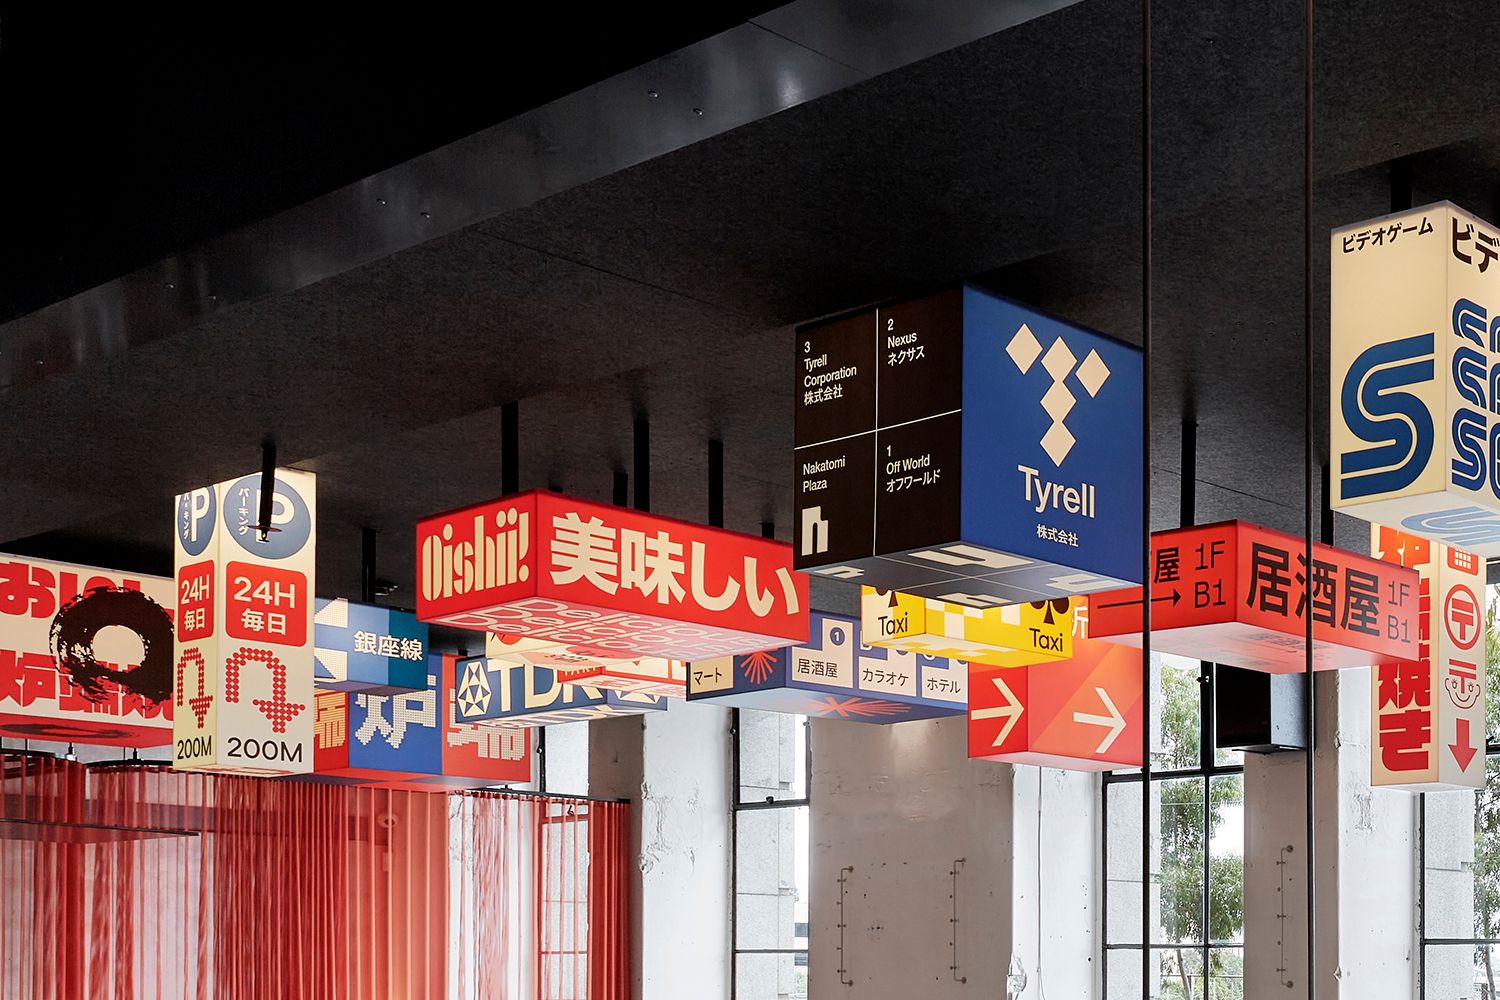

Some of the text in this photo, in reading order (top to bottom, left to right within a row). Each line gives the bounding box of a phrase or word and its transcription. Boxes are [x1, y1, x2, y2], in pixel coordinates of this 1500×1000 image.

[1342, 216, 1435, 255] ビデオゲーム
[887, 318, 894, 331] 2
[804, 341, 811, 353] 3
[887, 332, 918, 349] Nexus
[804, 354, 828, 372] Tyrell
[887, 345, 925, 367] ネクサス
[803, 366, 857, 388] Corporation
[803, 384, 843, 406] 株式会社
[886, 445, 892, 457] 1
[886, 453, 931, 475] Off World
[802, 455, 846, 476] Nakatomi
[802, 478, 828, 493] Plaza
[886, 469, 942, 493] オフワールド
[1017, 464, 1096, 519] Tyrell
[190, 485, 210, 543] P
[237, 487, 250, 537] パーキング
[1036, 523, 1080, 548] 株式会社
[421, 507, 531, 602] Oishii!
[549, 512, 801, 618] 美味しい
[1195, 539, 1227, 572] 1F
[181, 573, 211, 605] 24H
[233, 575, 297, 610] 24H
[1194, 578, 1228, 609] B1
[1246, 541, 1382, 638] 居酒屋
[1388, 579, 1412, 609] 1F
[183, 607, 206, 632] 毎日
[241, 608, 287, 635] 毎日
[878, 611, 909, 637] Taxi
[1387, 613, 1413, 645] B1
[353, 630, 424, 662] 銀座線
[1029, 627, 1064, 653] Taxi
[692, 666, 723, 687] マート
[796, 658, 839, 679] 居酒屋
[862, 668, 910, 687] カラオケ
[926, 677, 961, 694] ホテル
[177, 735, 213, 761] 200M
[227, 736, 303, 764] 200M
